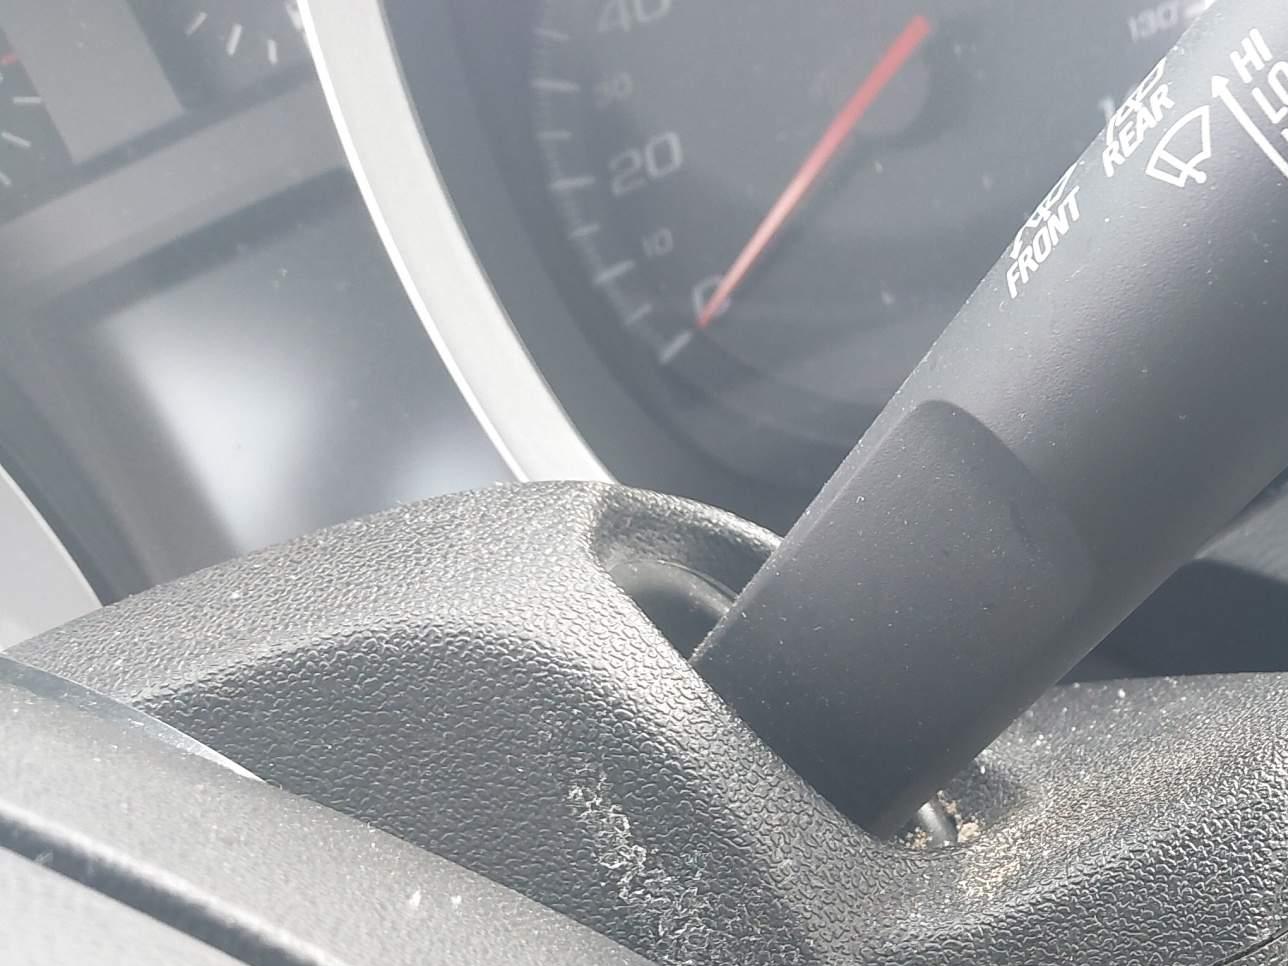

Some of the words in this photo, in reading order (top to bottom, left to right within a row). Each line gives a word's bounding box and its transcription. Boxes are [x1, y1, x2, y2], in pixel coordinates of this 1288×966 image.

[1230, 28, 1273, 83] HI
[1102, 84, 1175, 177] REAR
[609, 131, 684, 196] 20
[643, 228, 674, 257] 10
[1006, 185, 1080, 299] FRONT
